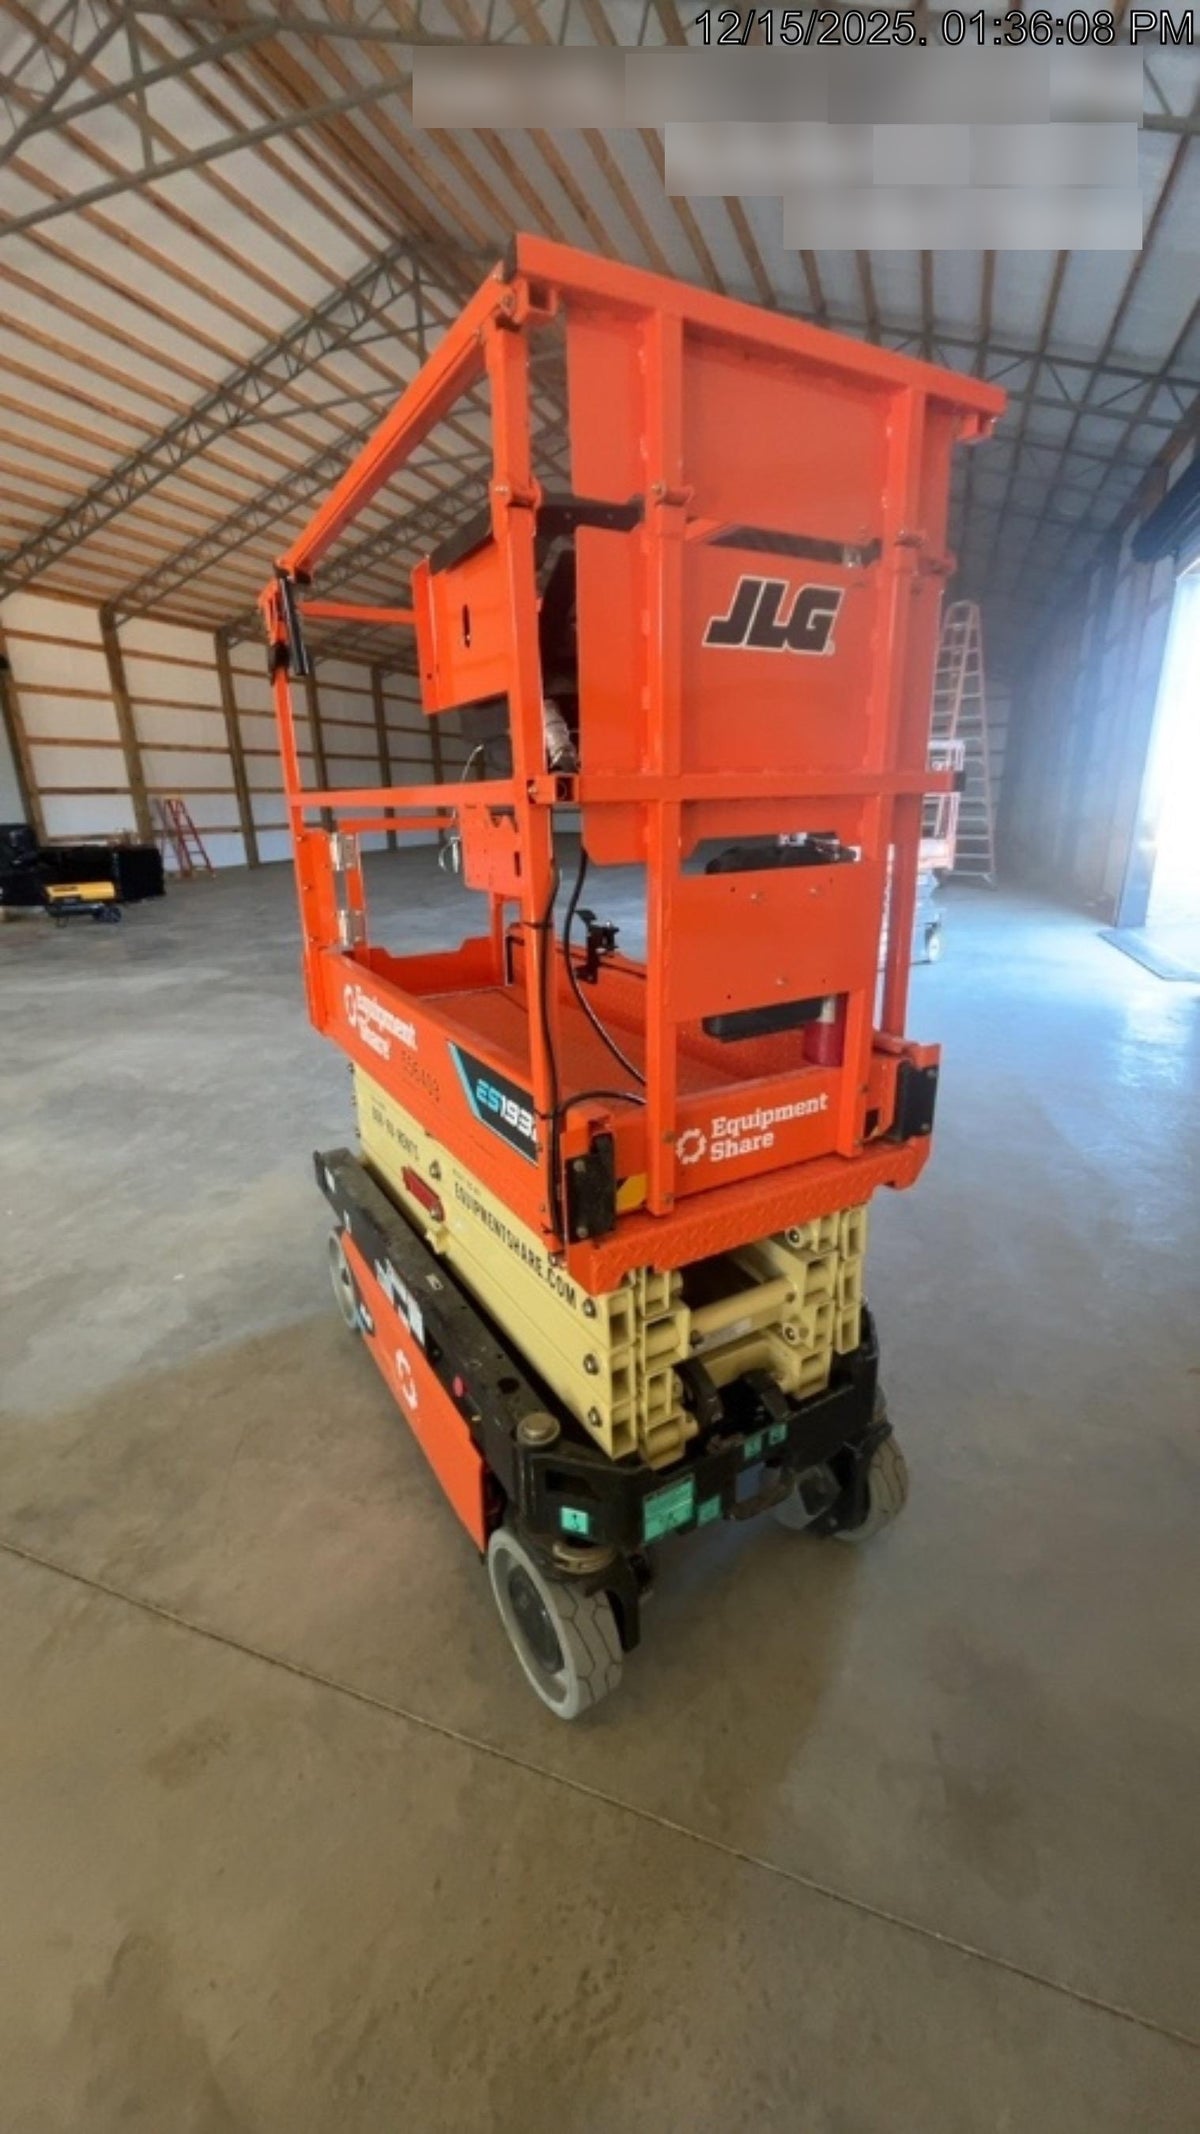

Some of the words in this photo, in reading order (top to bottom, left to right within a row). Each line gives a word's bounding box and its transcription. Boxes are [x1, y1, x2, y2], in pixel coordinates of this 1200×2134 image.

[702, 574, 845, 655] JLG
[475, 1078, 538, 1143] ES193
[711, 1092, 829, 1139] Equipment
[709, 1131, 775, 1163] Share
[454, 1182, 578, 1310] EQUIPMENTSHARE.COM
